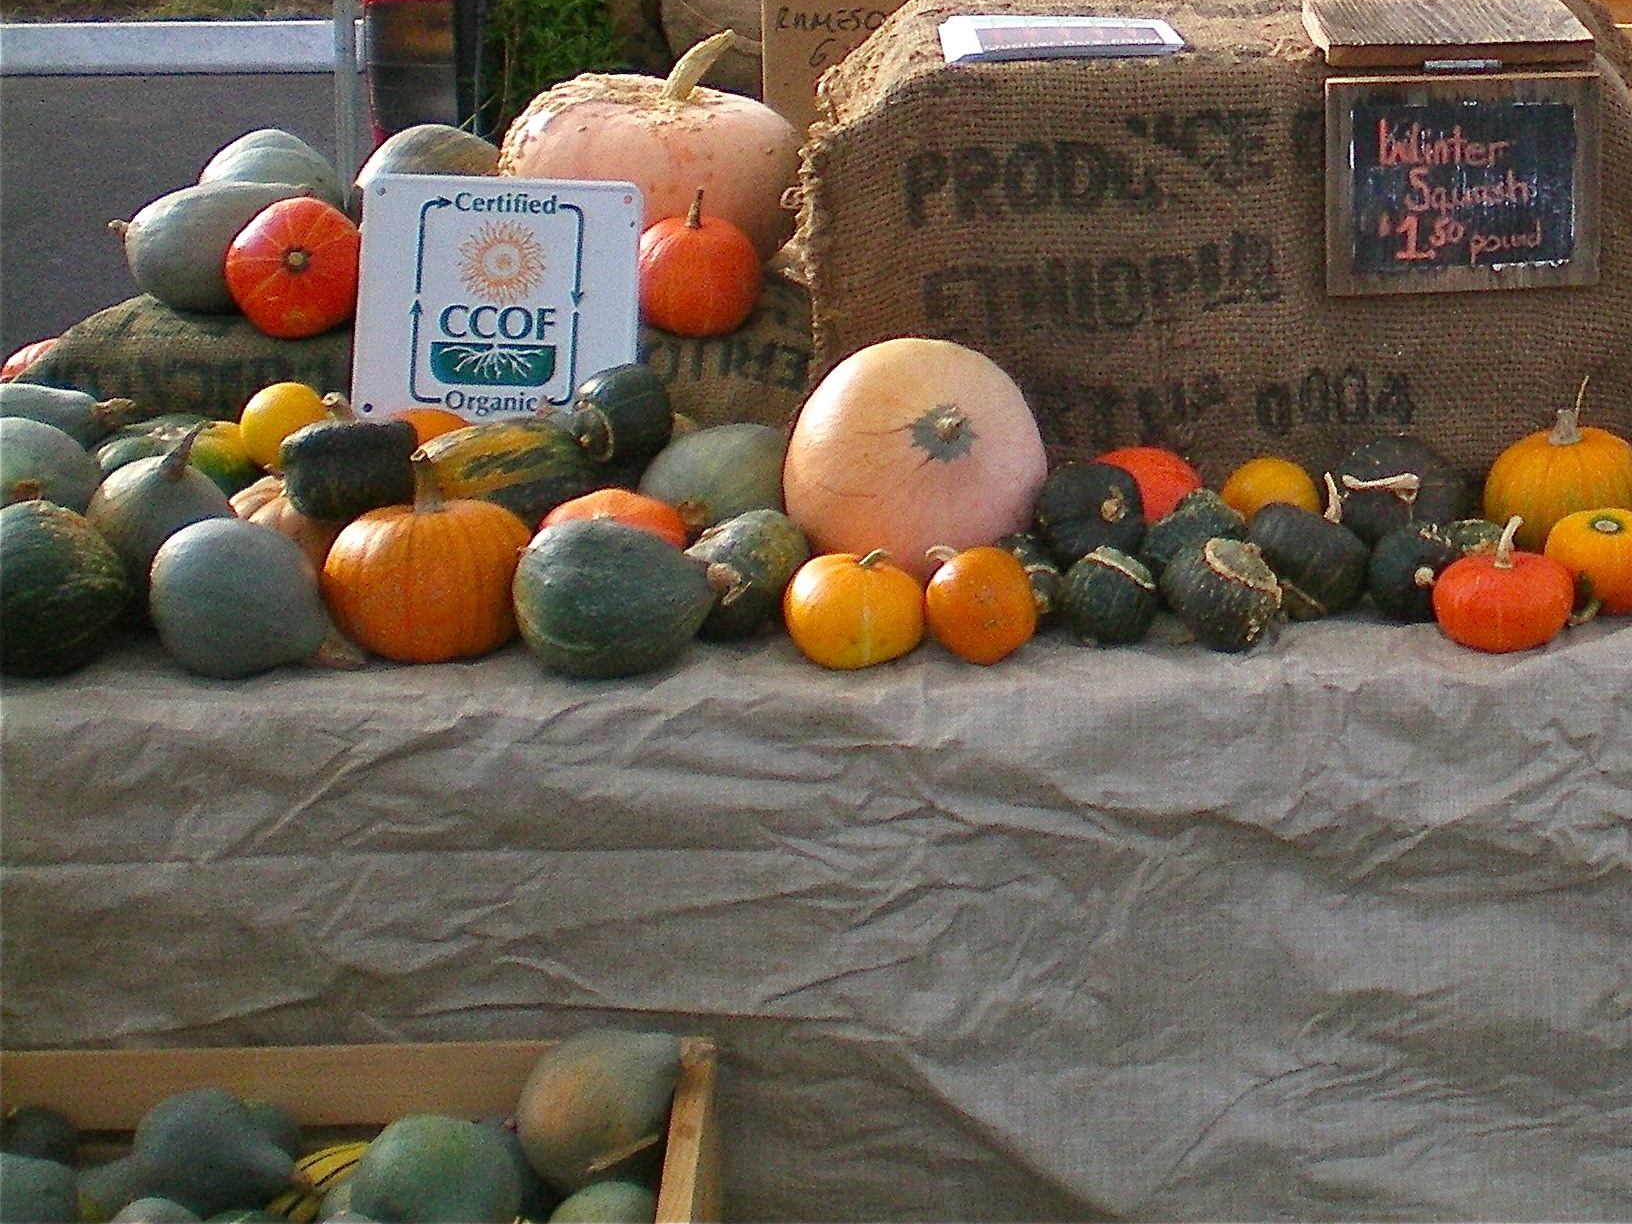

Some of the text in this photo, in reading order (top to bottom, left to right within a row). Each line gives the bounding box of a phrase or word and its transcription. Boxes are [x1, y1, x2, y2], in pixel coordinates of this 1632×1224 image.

[1377, 118, 1516, 168] Winter
[904, 108, 1273, 229] PRODUCE
[1403, 166, 1531, 219] Squash
[454, 191, 560, 216] Certified
[1469, 218, 1543, 267] pound
[438, 303, 557, 341] CCOF
[445, 389, 540, 417] Organic
